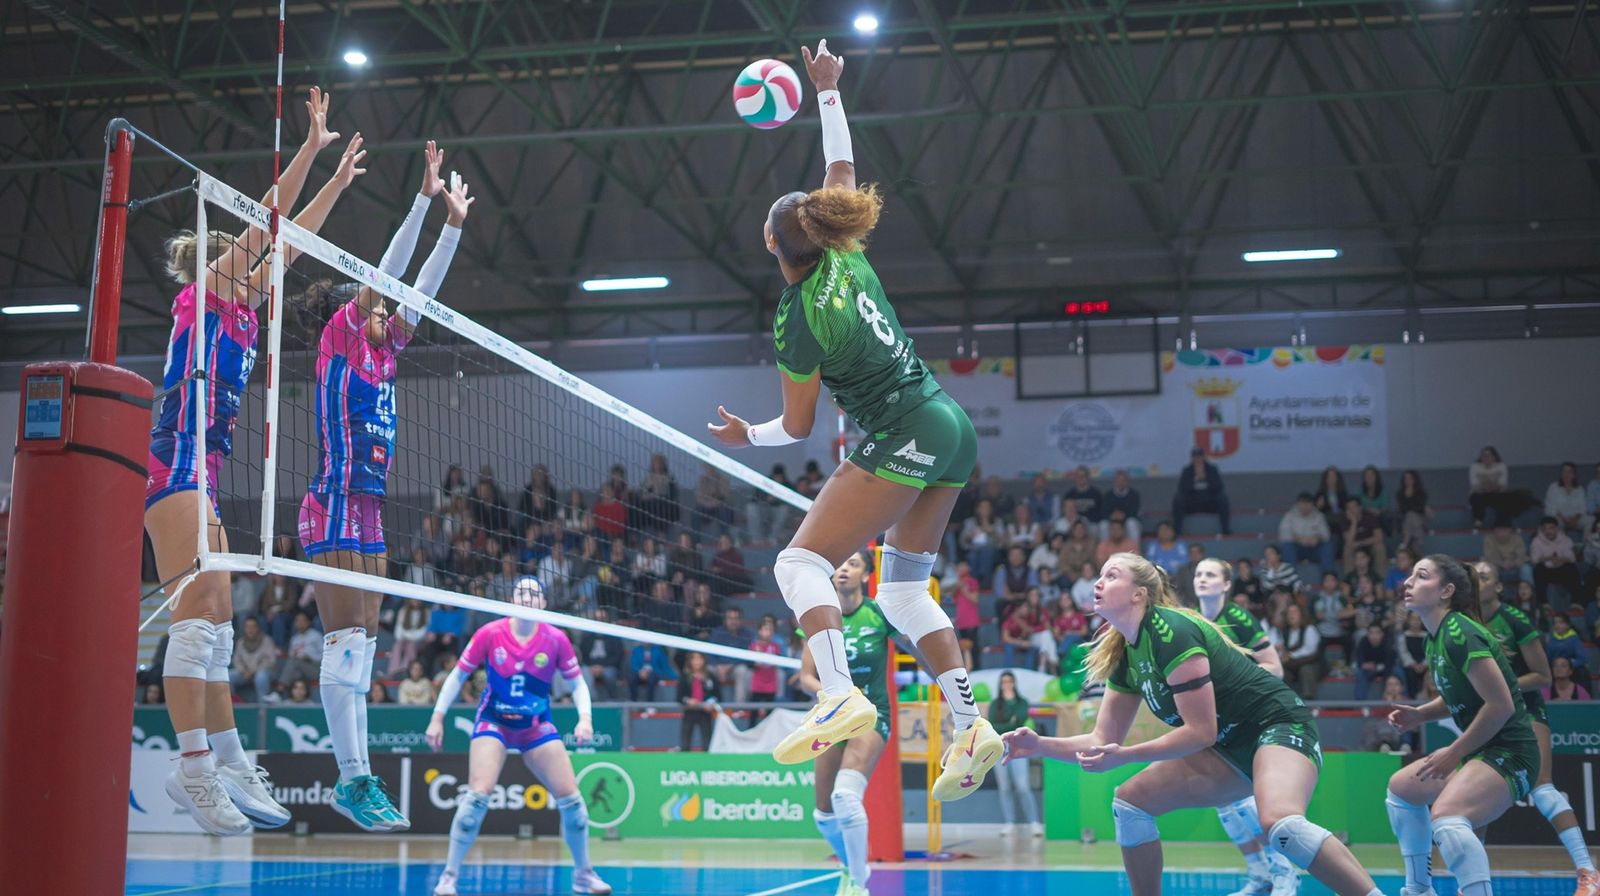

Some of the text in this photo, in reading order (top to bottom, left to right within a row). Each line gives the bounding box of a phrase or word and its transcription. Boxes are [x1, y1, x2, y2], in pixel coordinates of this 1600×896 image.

[856, 291, 895, 346] 8
[1249, 393, 1370, 412] Ayuntamiento de
[1250, 413, 1372, 428] Dos Hermanas
[862, 442, 876, 456] 8
[845, 637, 858, 661] 5
[510, 674, 526, 697] 2
[1551, 731, 1600, 749] putac
[660, 770, 699, 786] LIGA
[701, 770, 797, 786] IBERDROLA
[703, 798, 804, 821] Iberdrola
